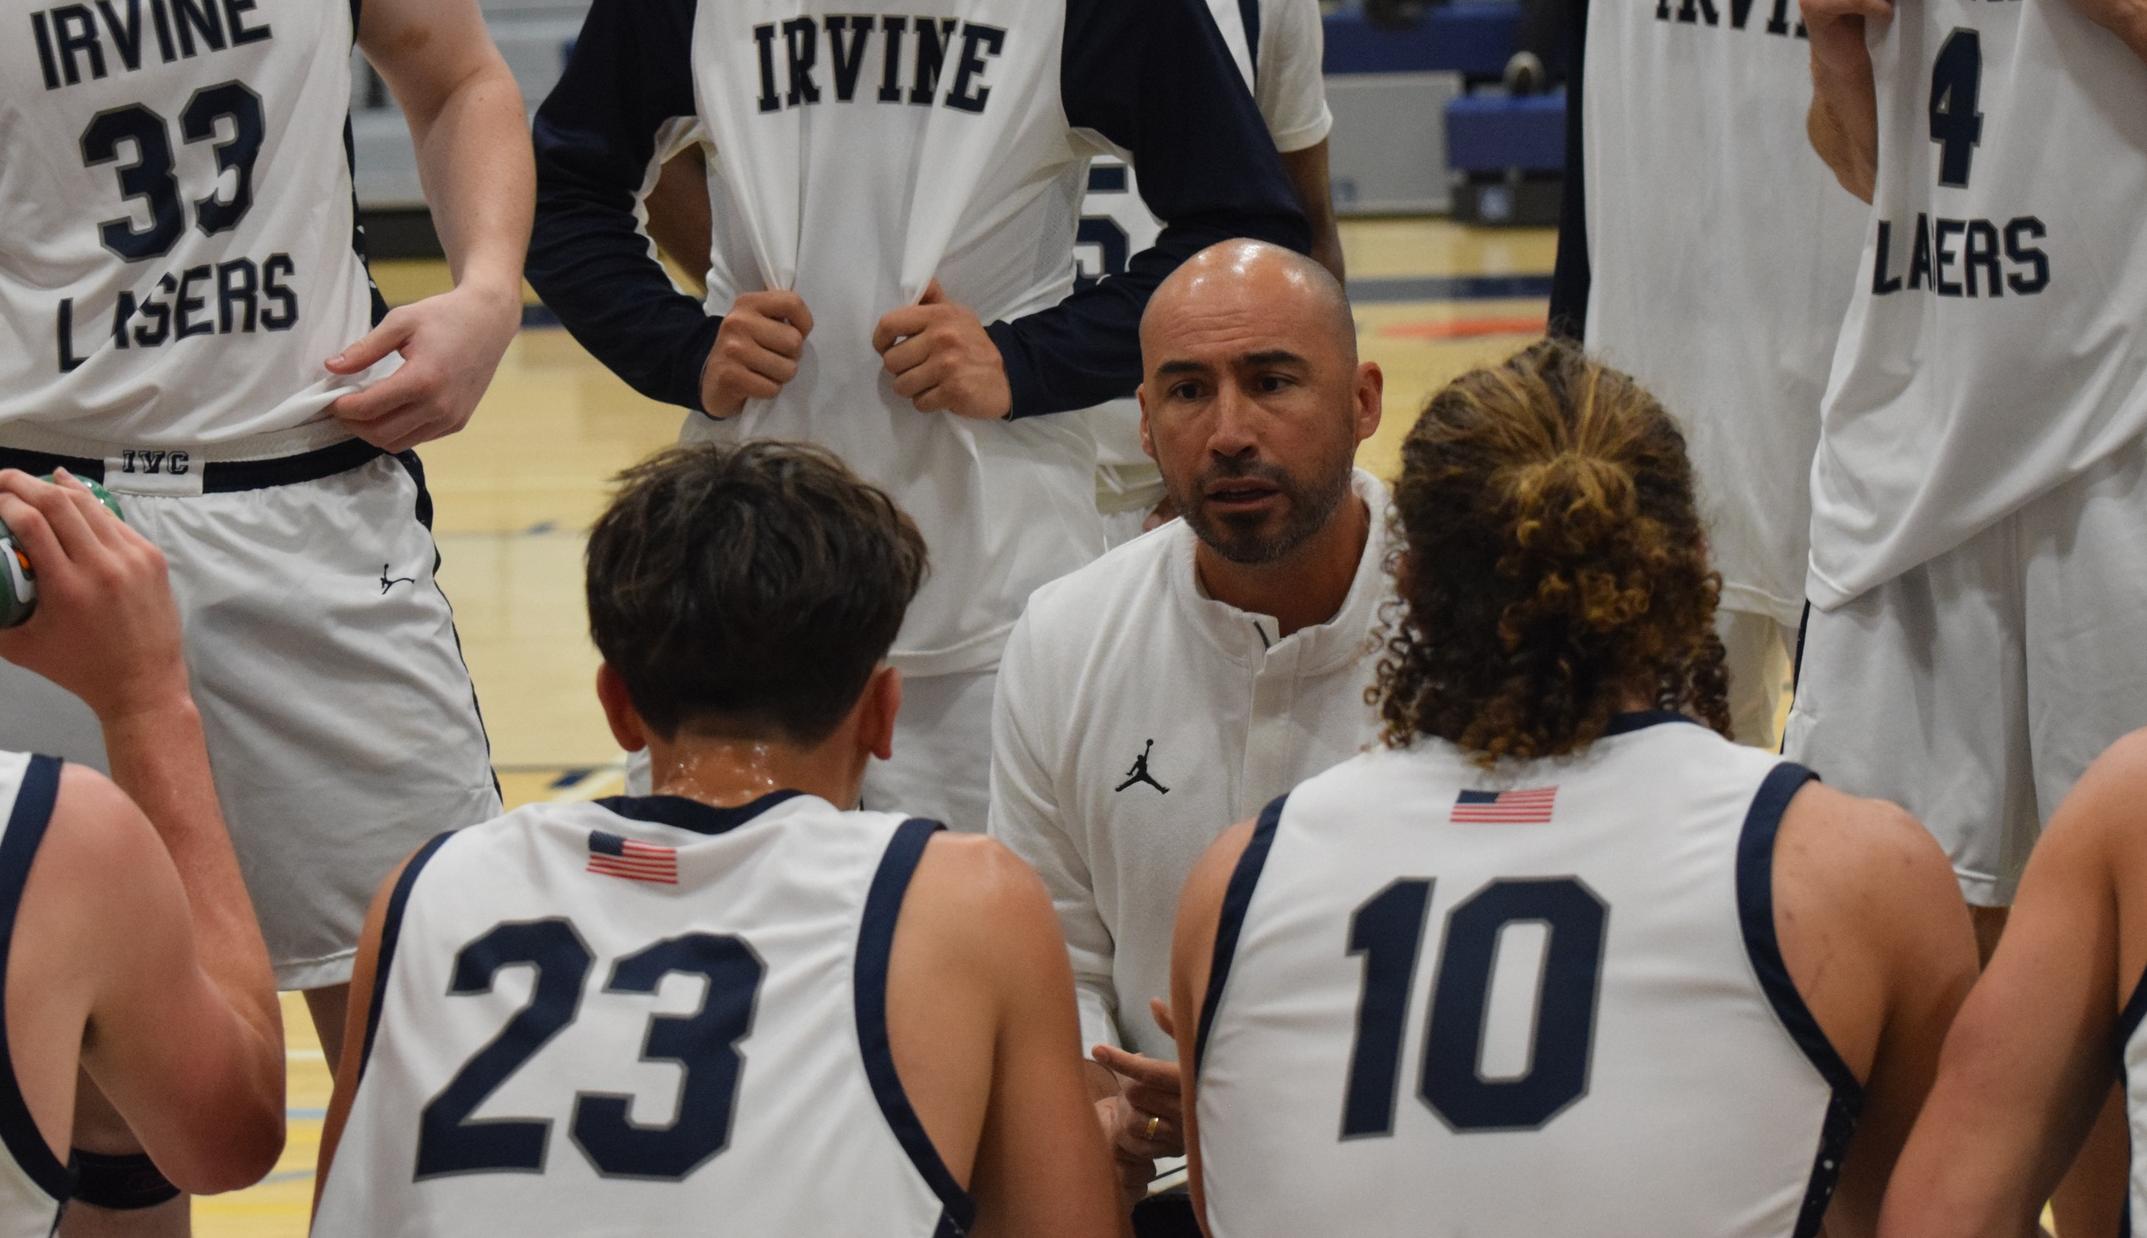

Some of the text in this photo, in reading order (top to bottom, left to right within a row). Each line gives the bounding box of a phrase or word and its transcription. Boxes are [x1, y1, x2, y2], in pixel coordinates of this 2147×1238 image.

[753, 13, 1008, 115] IRVINE
[1927, 26, 1985, 190] 4
[78, 79, 266, 263] 33
[122, 449, 189, 475] IVC
[413, 915, 769, 1184] 23
[1338, 874, 1611, 1143] 10
